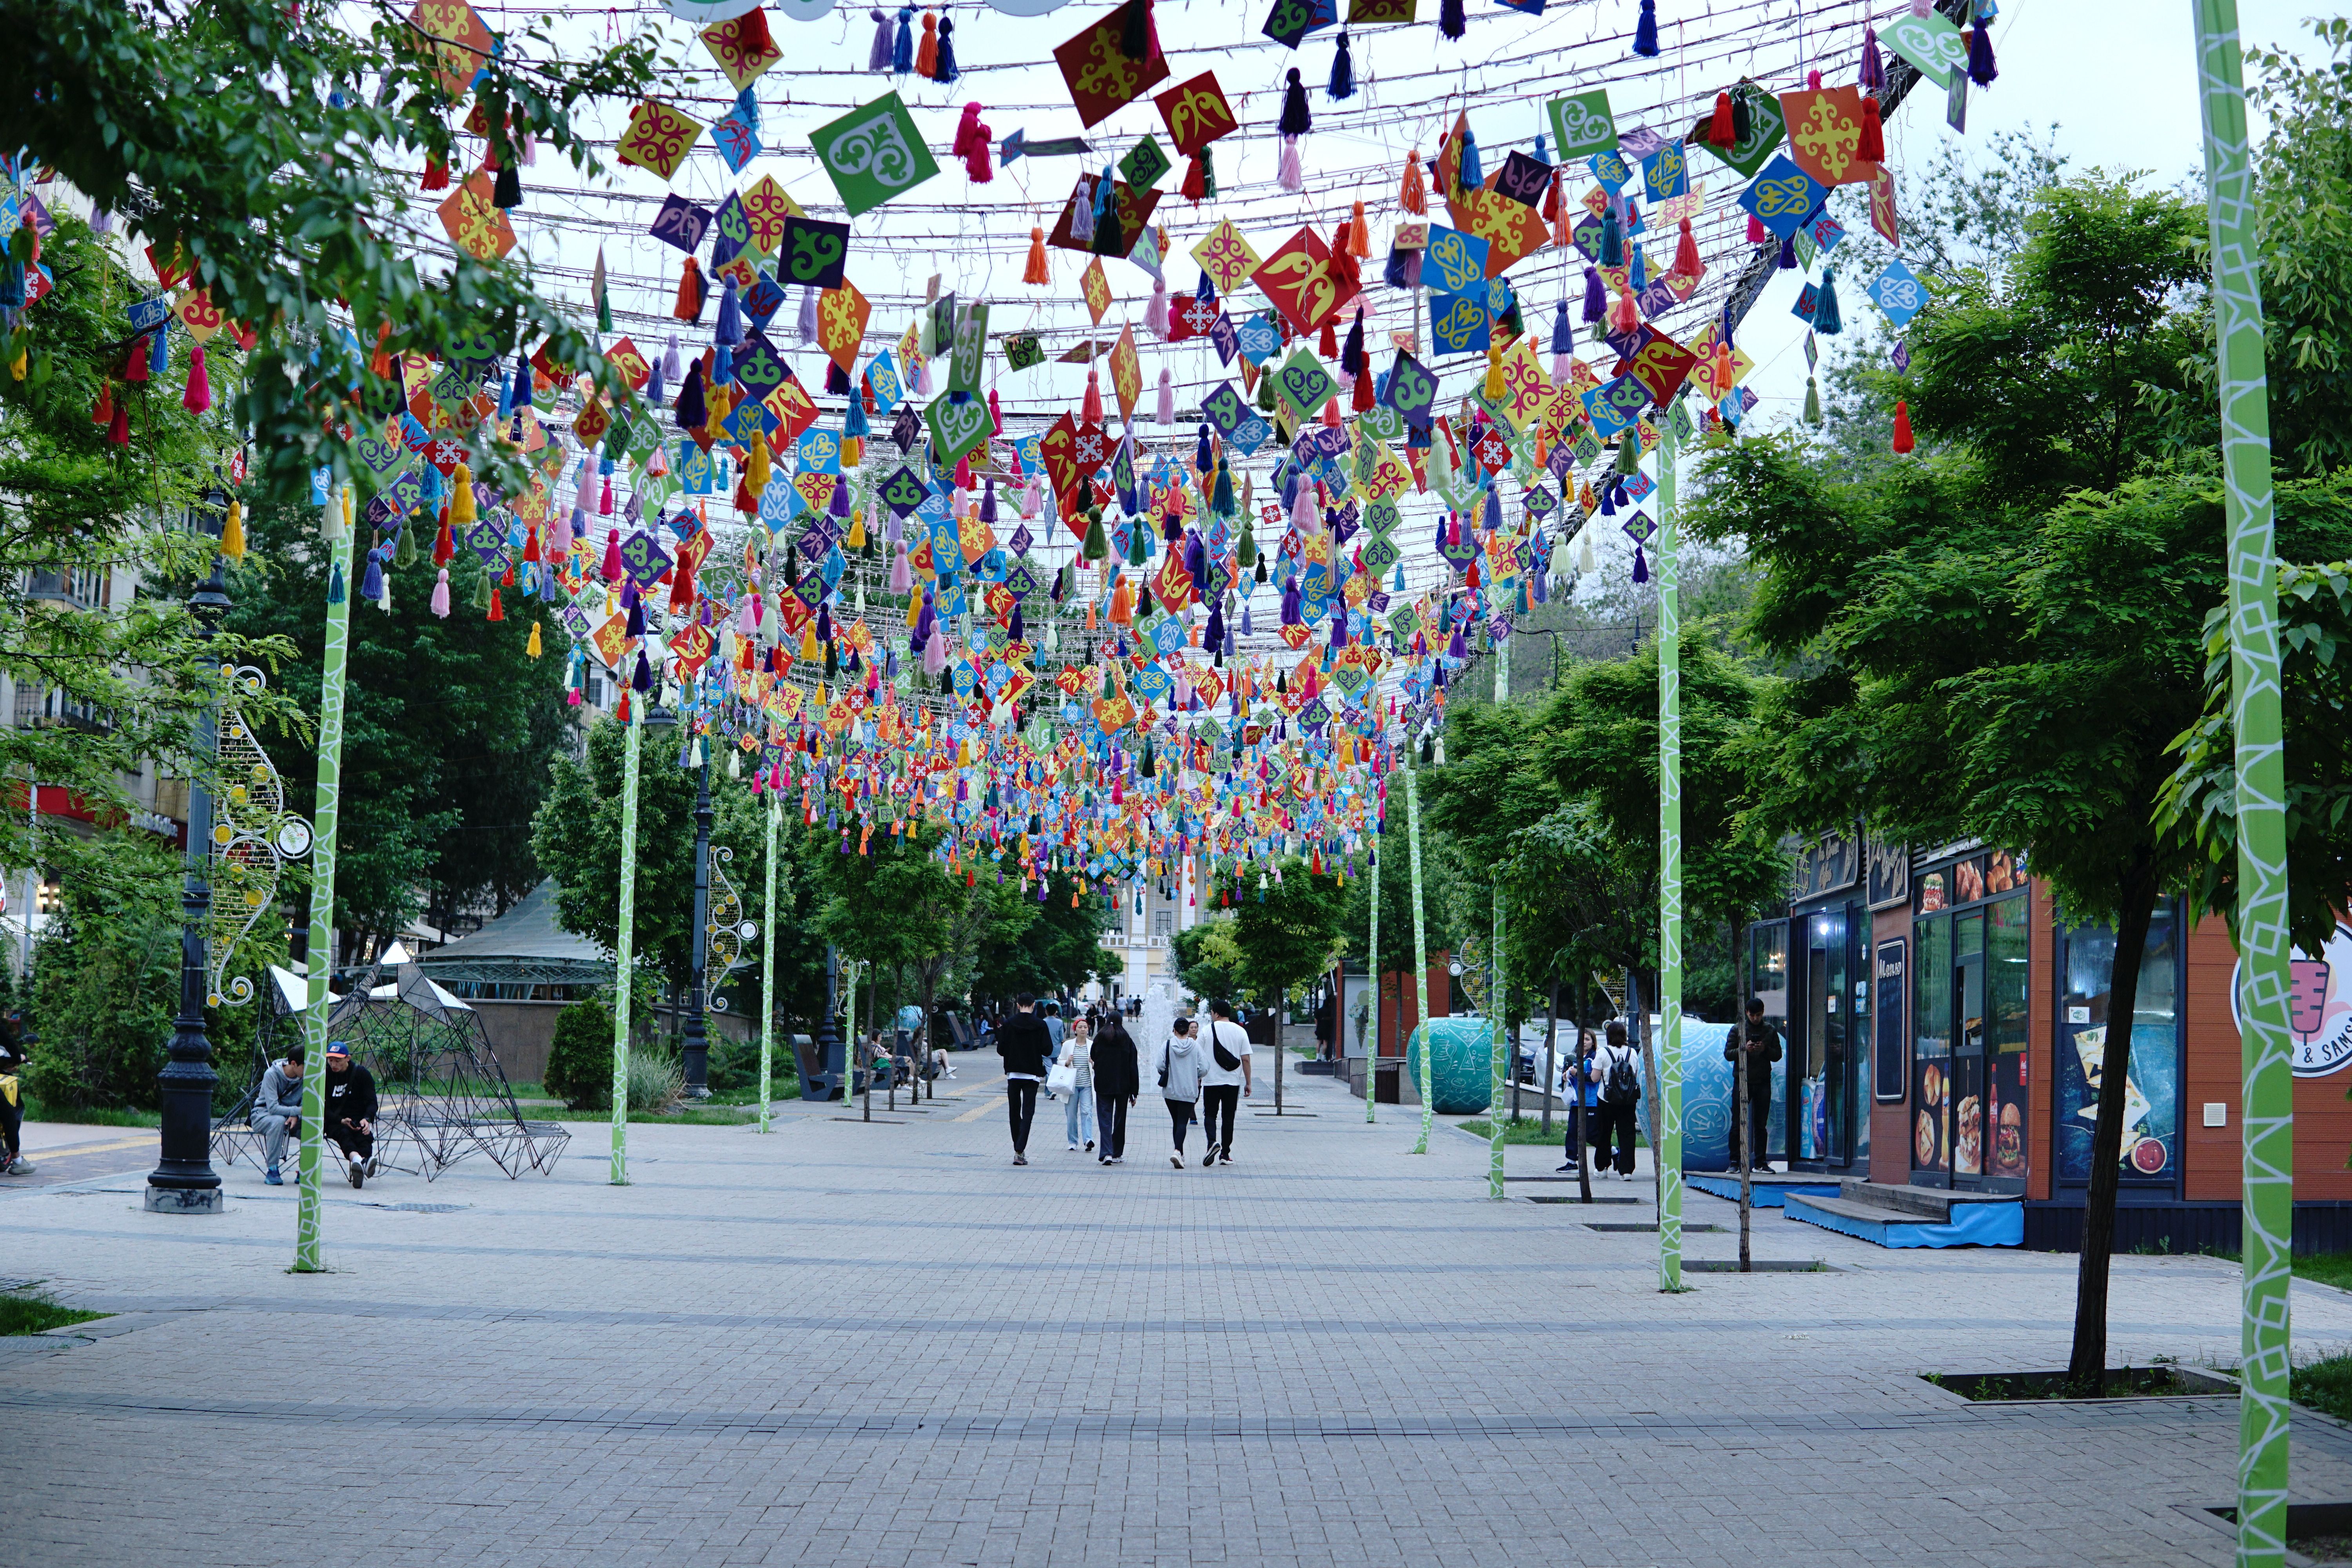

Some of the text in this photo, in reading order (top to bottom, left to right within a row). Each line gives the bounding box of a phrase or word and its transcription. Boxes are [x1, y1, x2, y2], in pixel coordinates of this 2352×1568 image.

[1878, 959, 1902, 979] Меню
[2304, 1017, 2352, 1063] & SAMS
